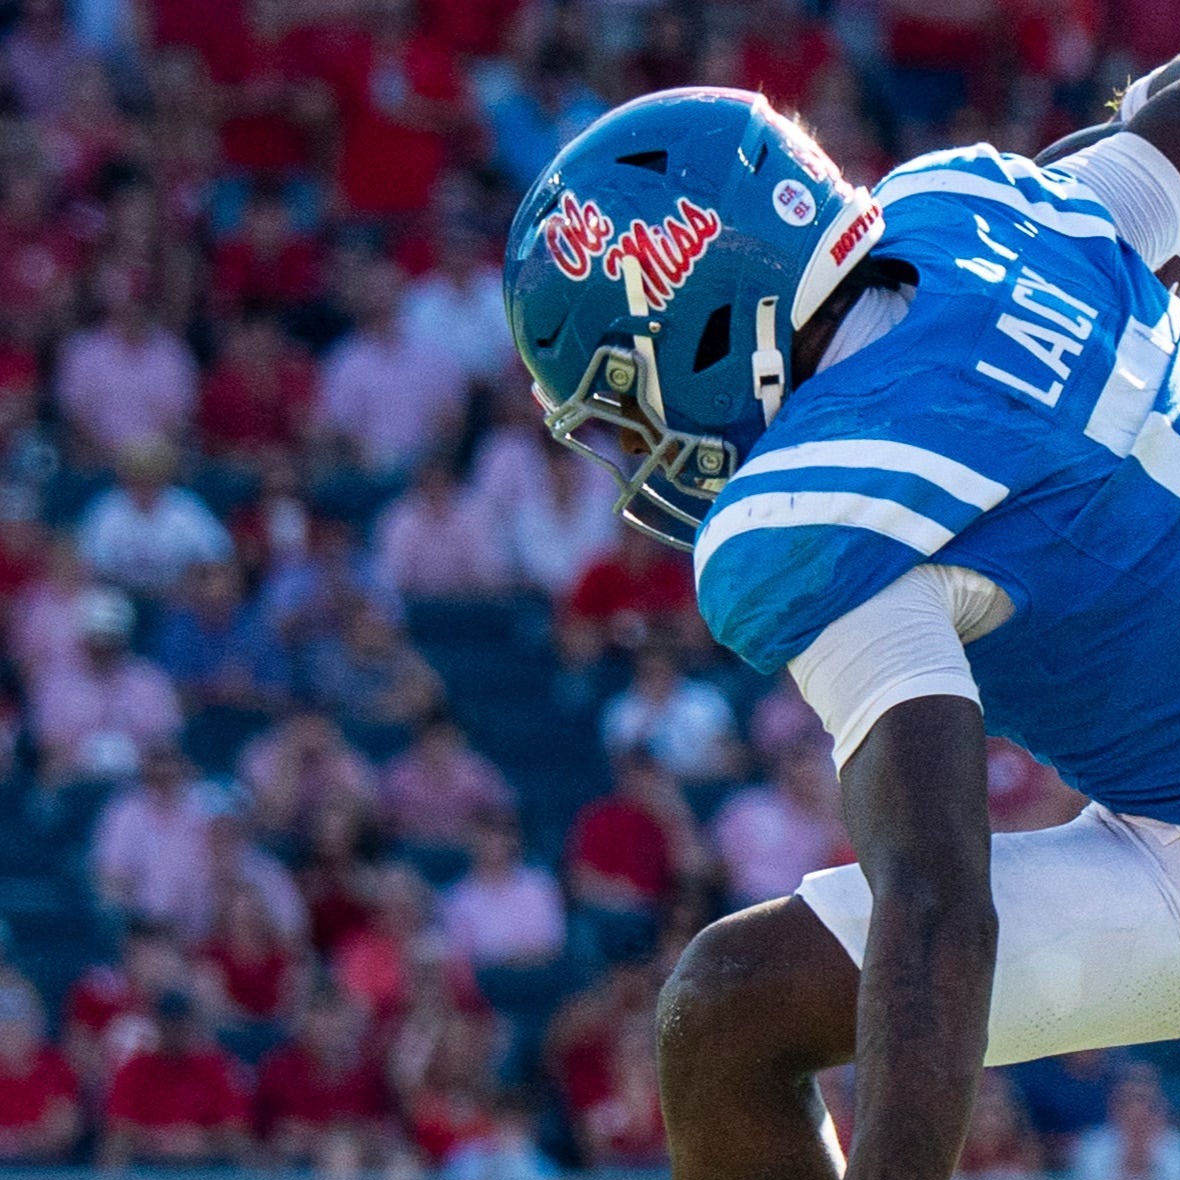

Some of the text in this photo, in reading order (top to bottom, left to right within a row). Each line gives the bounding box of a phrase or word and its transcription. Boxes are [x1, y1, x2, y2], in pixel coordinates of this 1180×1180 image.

[545, 190, 721, 310] Ole Miss
[793, 200, 811, 219] 91
[975, 266, 1098, 408] LACY
